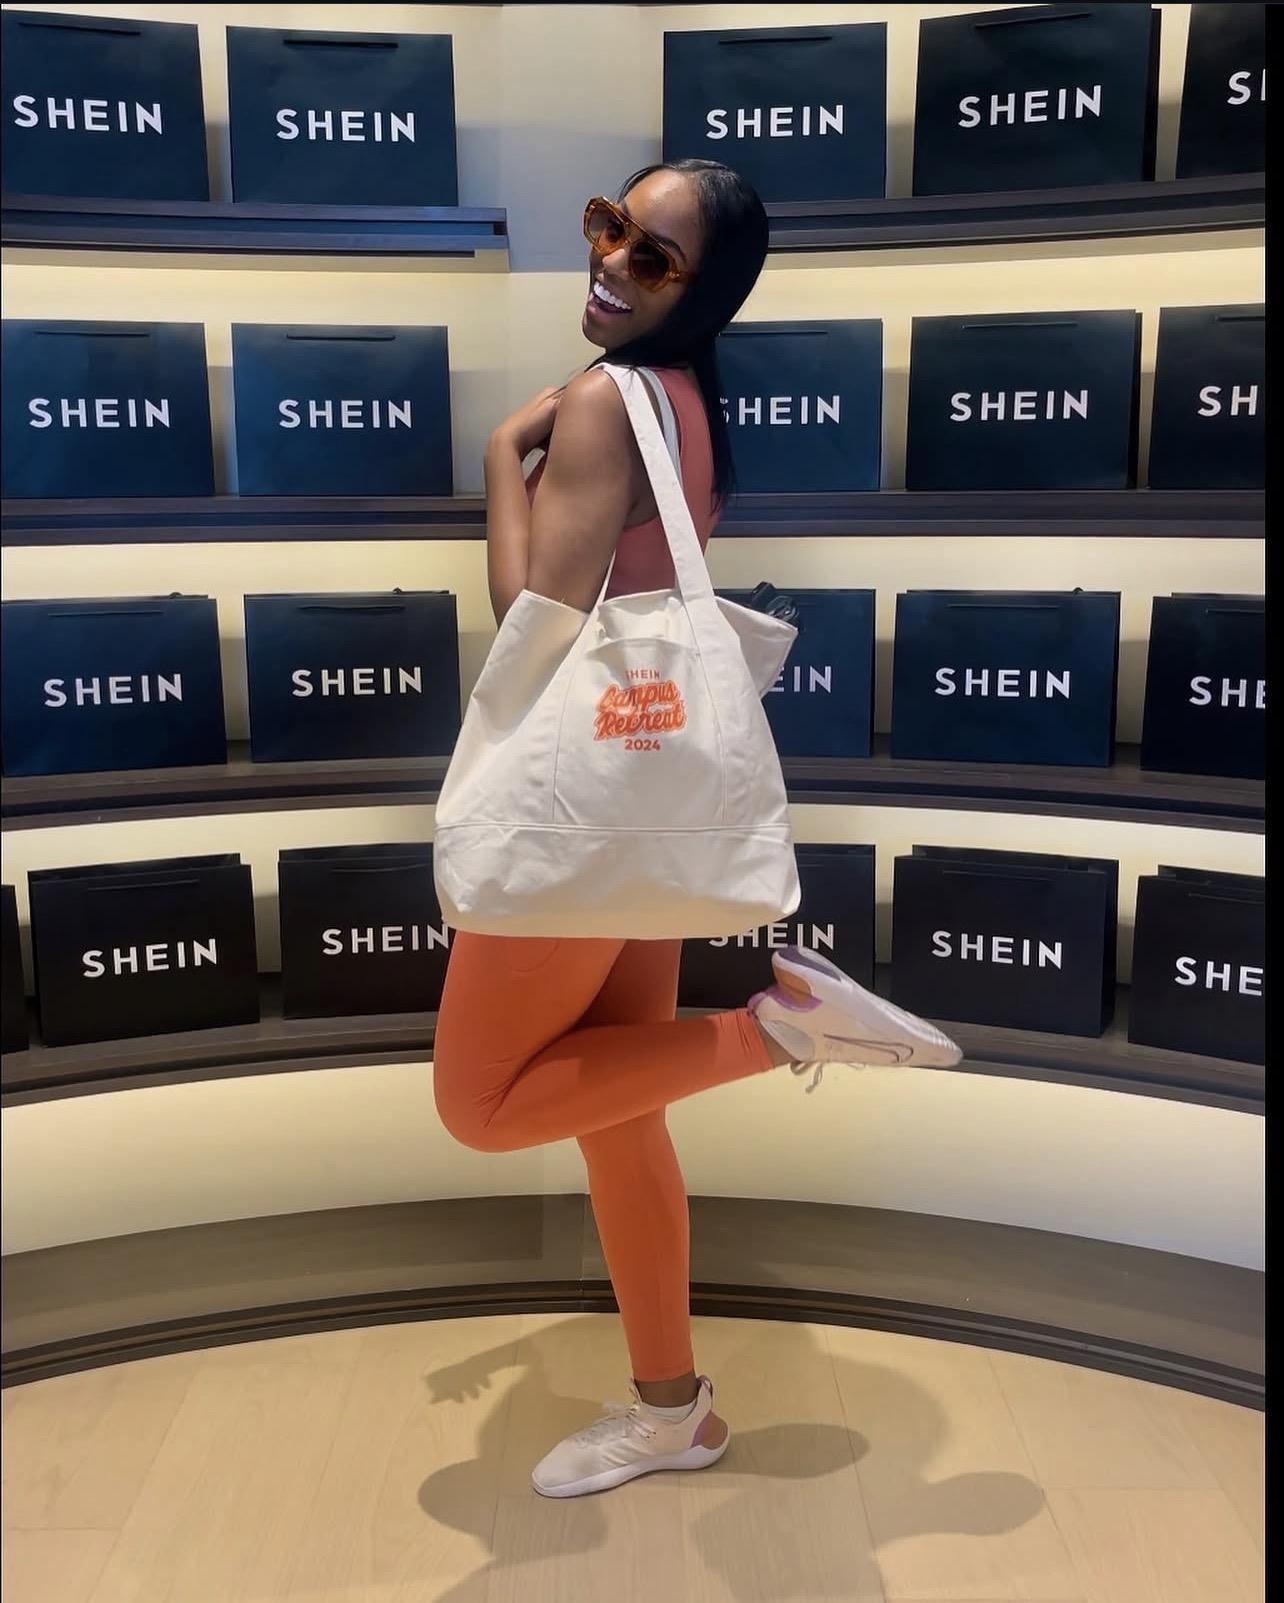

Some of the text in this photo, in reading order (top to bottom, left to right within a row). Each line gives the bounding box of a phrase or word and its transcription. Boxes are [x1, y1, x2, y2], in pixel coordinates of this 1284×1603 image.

[1227, 69, 1266, 105] S
[13, 94, 162, 135] SHEIN
[706, 105, 844, 140] SHEIN
[958, 85, 1102, 128] SHEIN
[276, 109, 415, 142] SHEIN
[28, 398, 170, 428] SHEIN
[278, 400, 412, 428] SHEIN
[950, 390, 1088, 422] SHEIN
[1197, 385, 1258, 417] SH
[44, 675, 182, 707] SHEIN
[292, 667, 422, 698] SHEIN
[599, 681, 679, 711] Campus
[935, 668, 1070, 699] SHEIN
[595, 704, 686, 739] Retreat
[624, 739, 661, 751] 2024
[322, 924, 449, 956] SHEIN
[932, 930, 1062, 969] SHEIN
[82, 938, 217, 978] SHEIN
[1174, 956, 1264, 996] SHE
